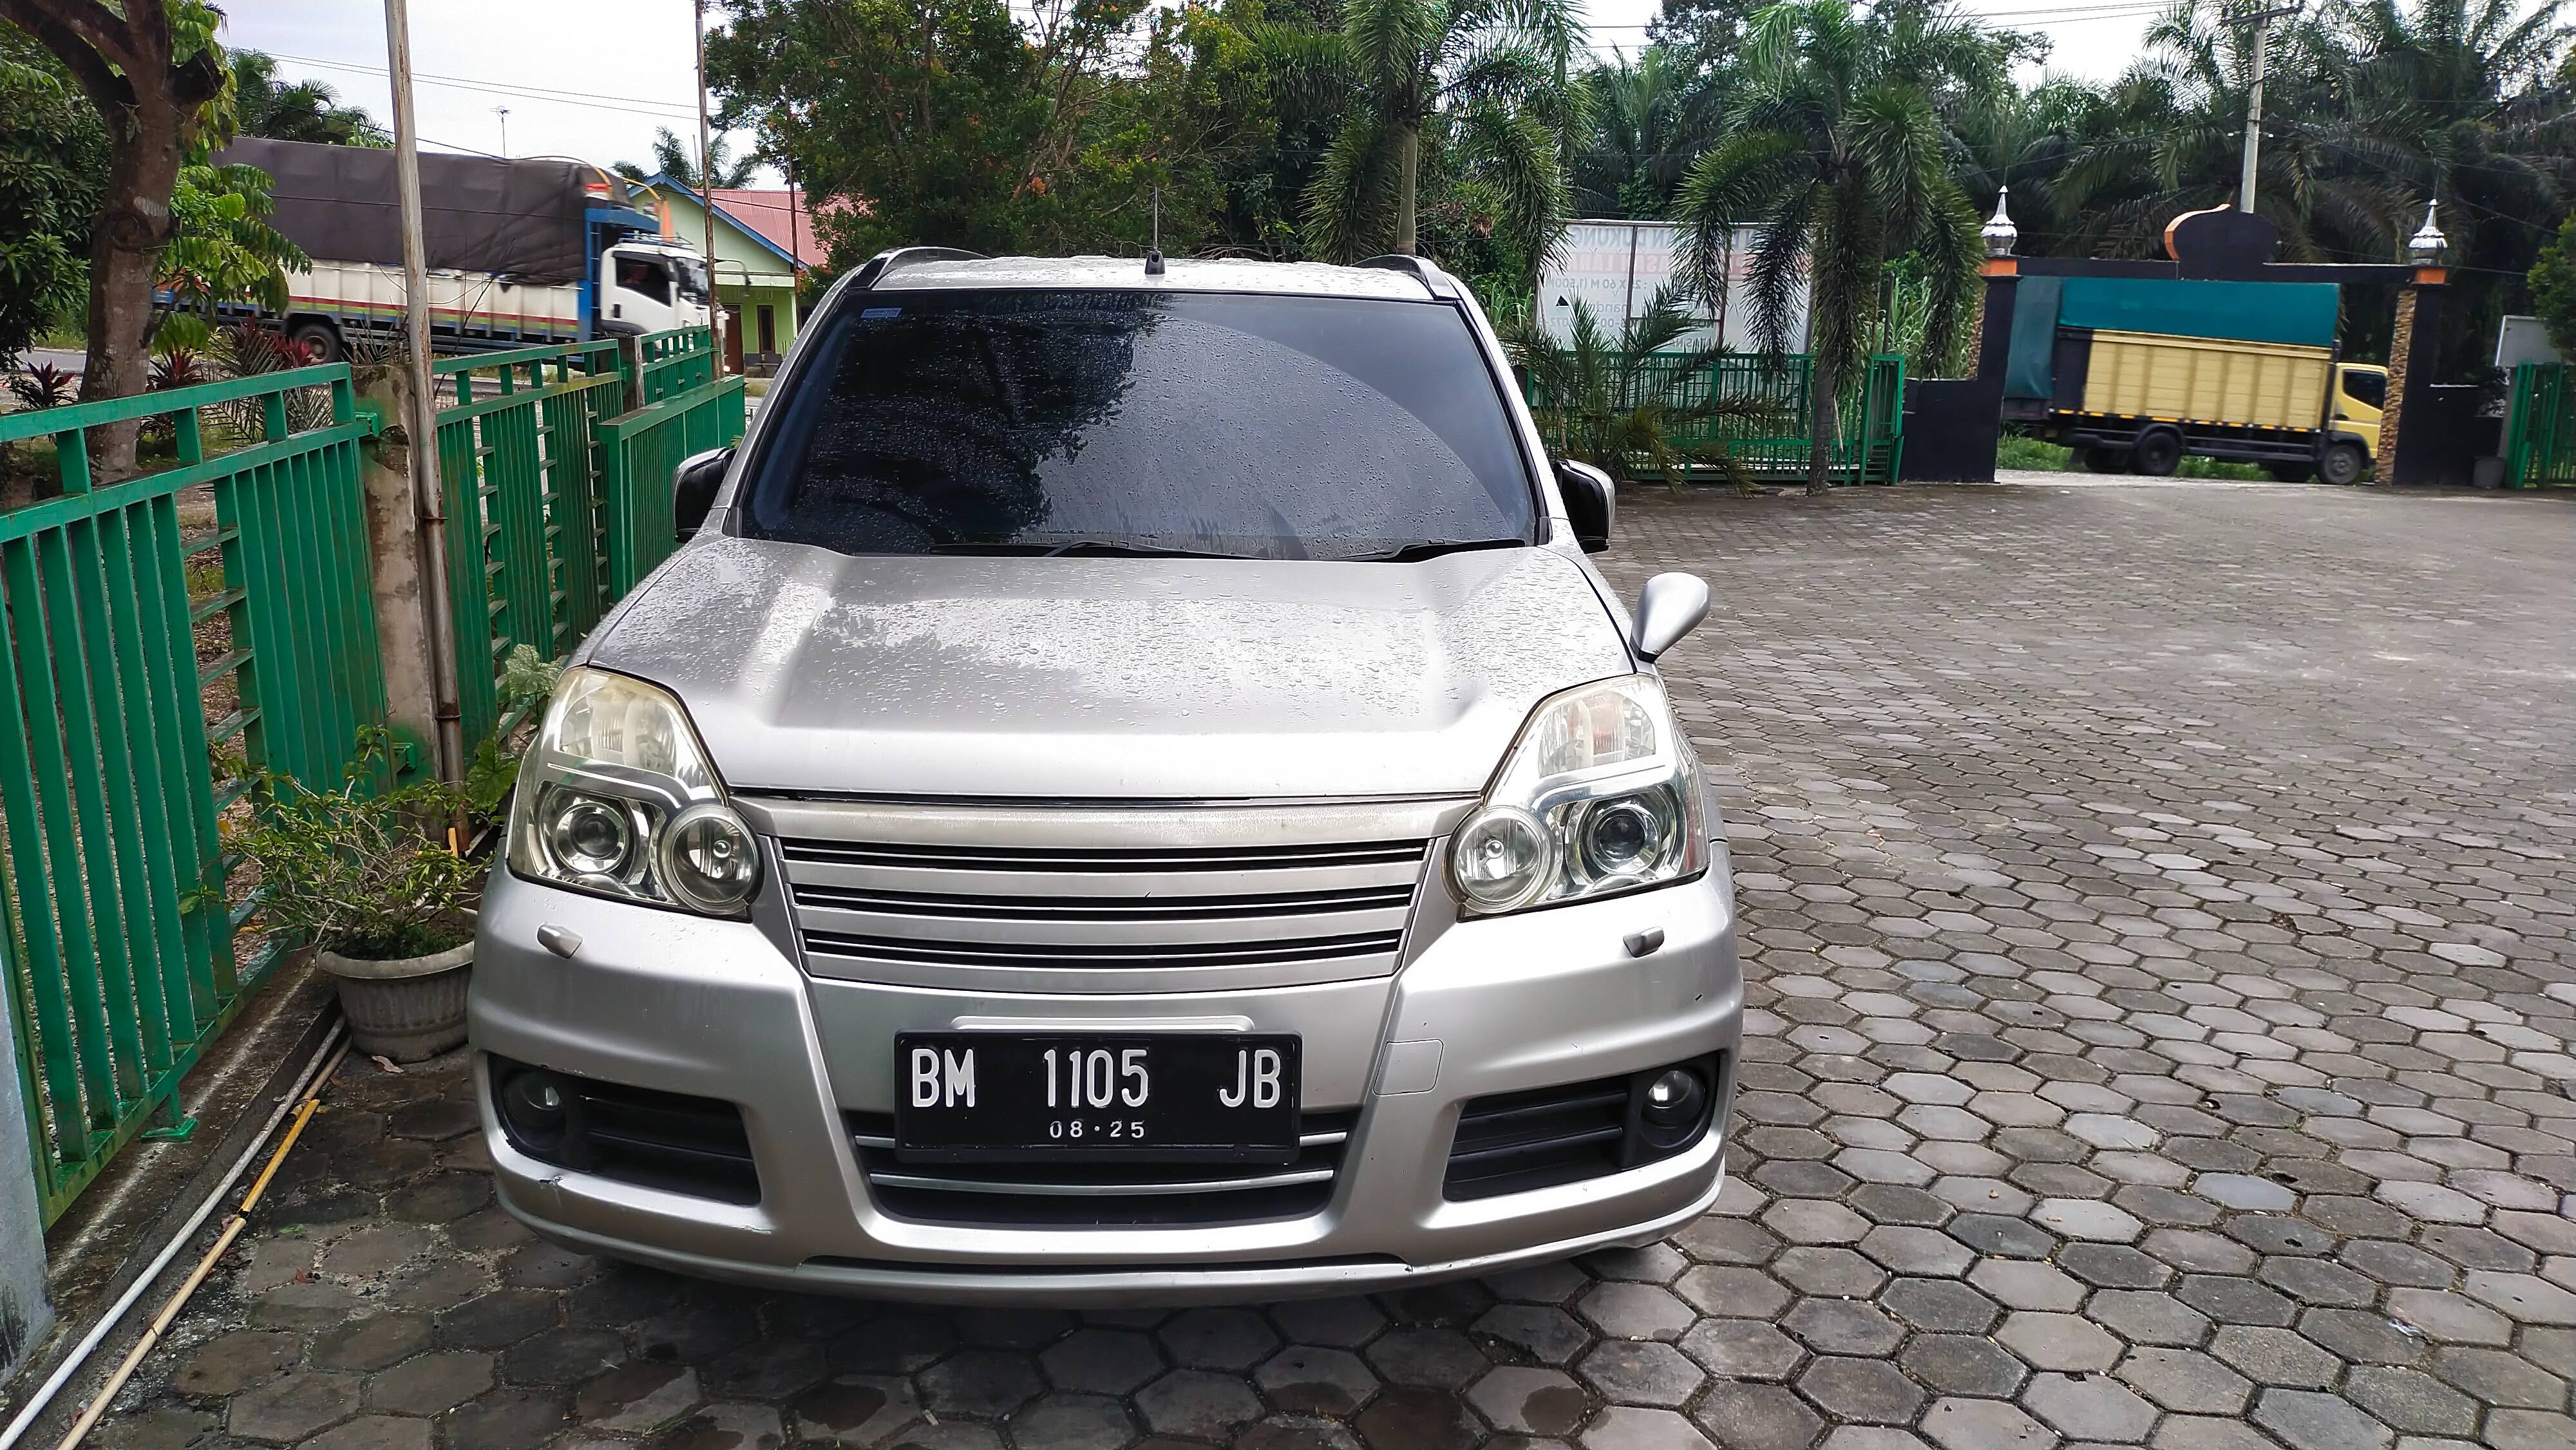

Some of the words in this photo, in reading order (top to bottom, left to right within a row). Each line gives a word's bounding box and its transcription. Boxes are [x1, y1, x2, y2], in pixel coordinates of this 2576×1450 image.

[911, 1048, 976, 1108] BM
[1043, 1048, 1149, 1108] 1105
[1219, 1048, 1281, 1109] JB
